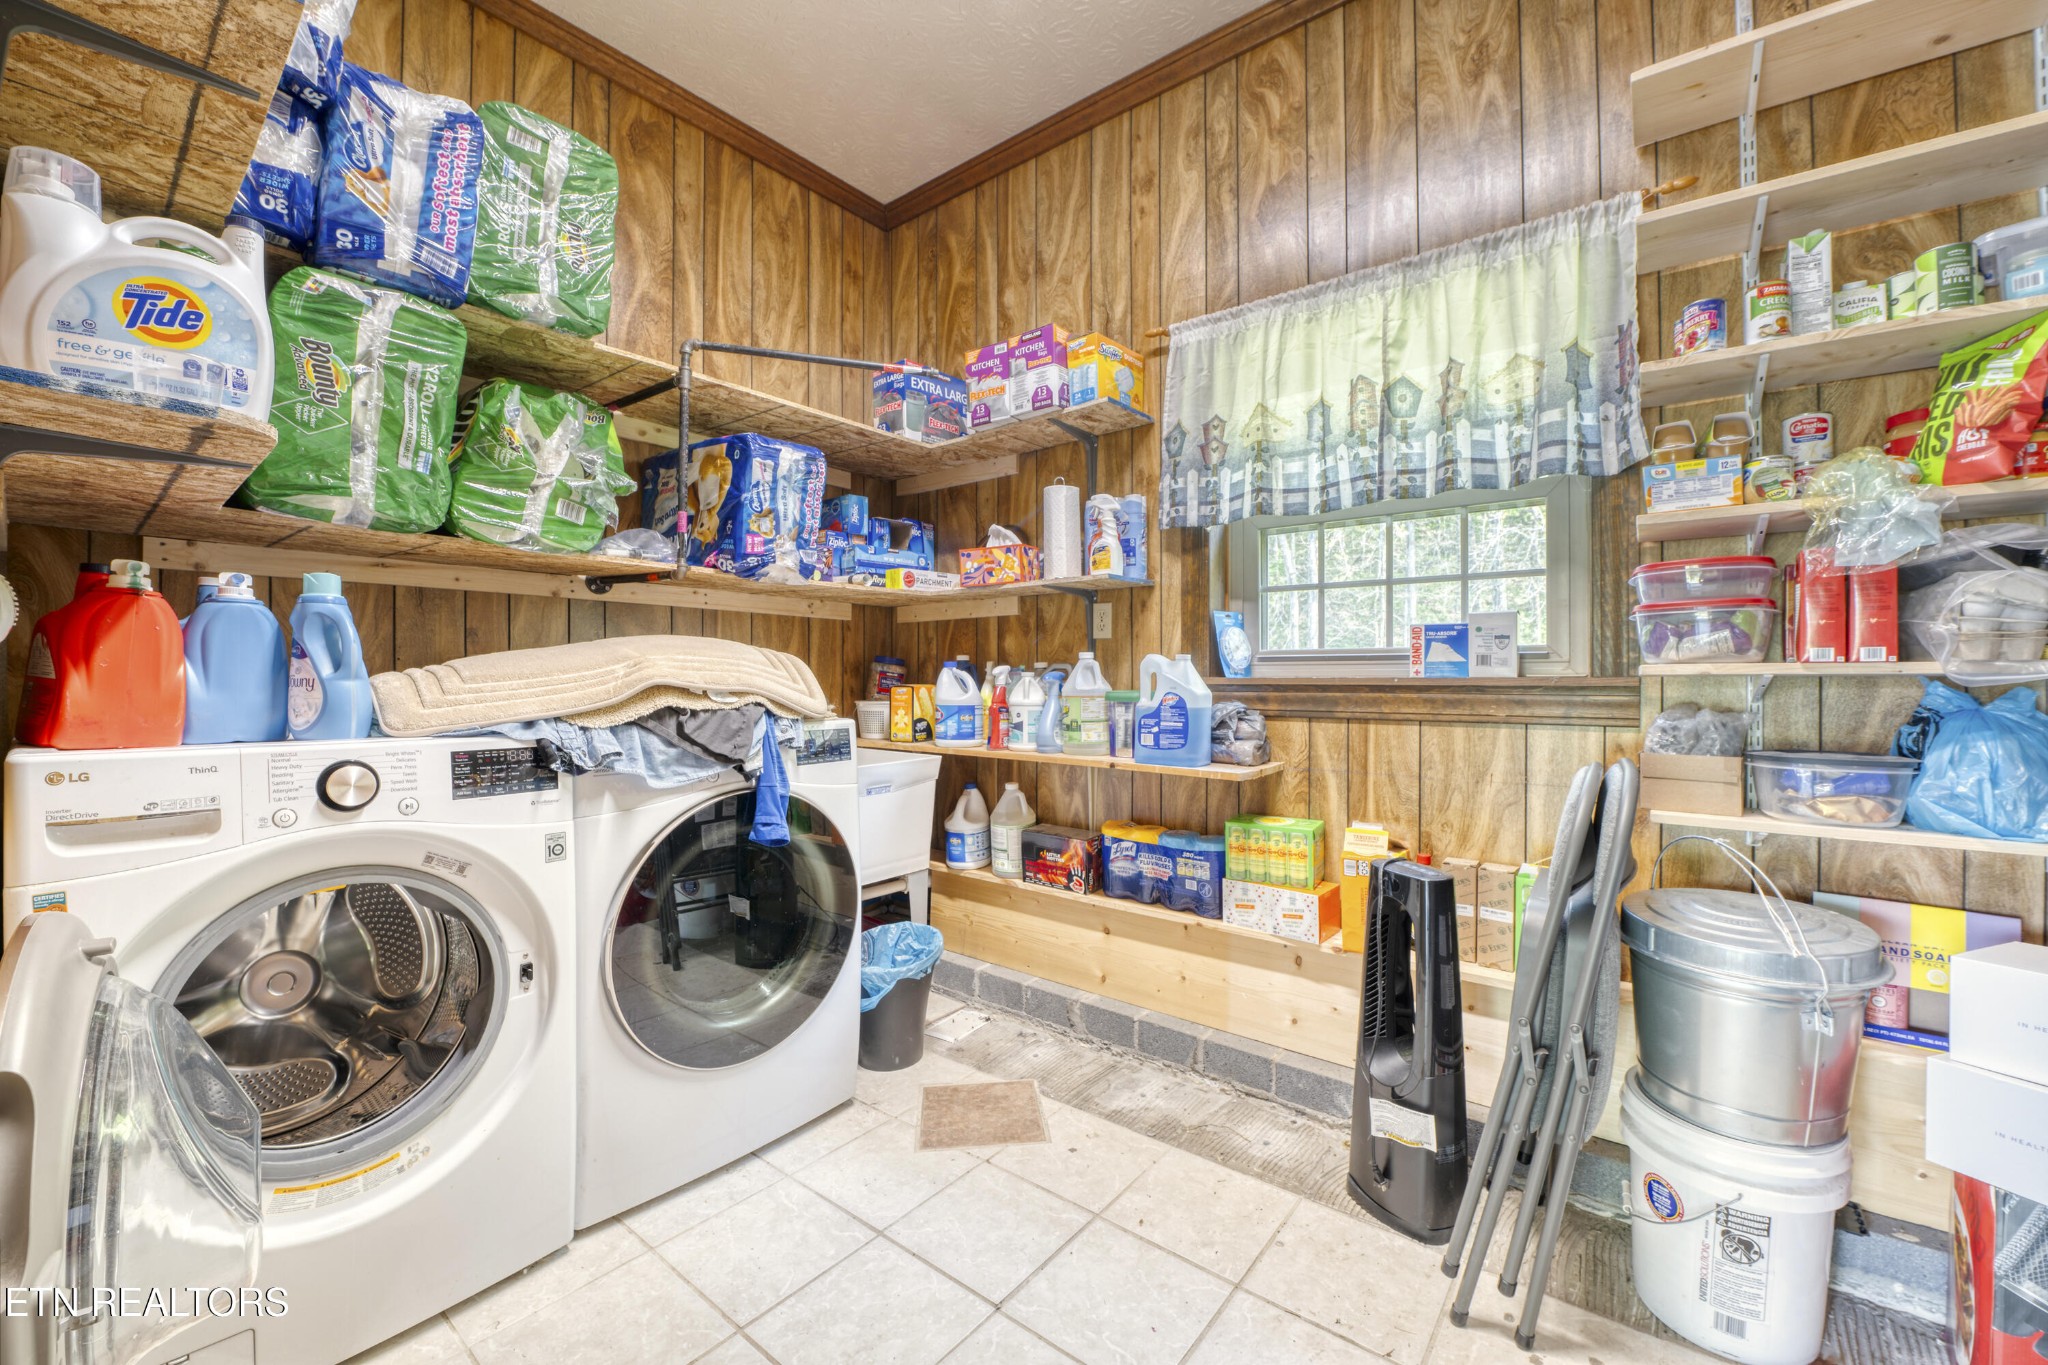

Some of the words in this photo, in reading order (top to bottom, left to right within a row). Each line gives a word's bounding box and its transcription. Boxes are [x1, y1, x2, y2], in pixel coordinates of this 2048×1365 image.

[259, 178, 289, 190] WIDER
[433, 153, 451, 211] softest
[259, 195, 290, 215] 30
[431, 212, 441, 234] OUR
[444, 209, 460, 254] most
[336, 228, 354, 250] 30
[1942, 266, 1970, 279] COCONUT
[1942, 276, 1971, 286] MILK
[1764, 285, 1789, 294] ZATARA
[1759, 295, 1789, 307] CREO
[1838, 296, 1878, 308] CALIFIA
[122, 291, 205, 330] Tide
[56, 319, 71, 327] 152
[57, 337, 92, 352] free
[95, 345, 111, 356] &
[1015, 341, 1045, 356] KITCHEN
[1098, 342, 1122, 360] Swiffer
[289, 343, 311, 391] Advanced
[971, 358, 1000, 372] KITCHEN
[299, 336, 342, 409] Bounty
[873, 377, 887, 389] EXTRA
[887, 373, 904, 383] LARGE
[911, 376, 943, 397] EXTRA
[944, 387, 968, 405] LARG
[969, 383, 1006, 402] FLEX-TECH
[1037, 386, 1047, 396] 13
[875, 400, 902, 416] FLEX-TECH
[976, 404, 985, 414] 13
[928, 417, 959, 433] FLEX-TECH
[1790, 421, 1828, 434] Carnation
[1957, 428, 1990, 445] HOT
[402, 432, 412, 461] DURABLE
[1956, 440, 1987, 452] CHEDDAR
[1721, 461, 1729, 469] 12
[828, 536, 849, 548] Ziploc
[916, 577, 953, 588] PARCHMENT
[1412, 626, 1423, 665] BAND-AID
[187, 765, 219, 775] ThinQ
[68, 772, 90, 783] LG
[45, 812, 99, 822] DirectDrive
[1112, 842, 1134, 856] Lysol
[34, 893, 65, 901] CERTIFIED
[1881, 945, 1909, 957] AND
[1913, 950, 1951, 963] SOA
[2017, 1021, 2029, 1029] IN
[1994, 1130, 2006, 1139] IN
[2010, 1136, 2048, 1153] HEALT
[1729, 1208, 1769, 1223] WARNING
[1729, 1215, 1769, 1229] AVERTISSEMENT
[1728, 1222, 1768, 1236] ADVERTENCIA
